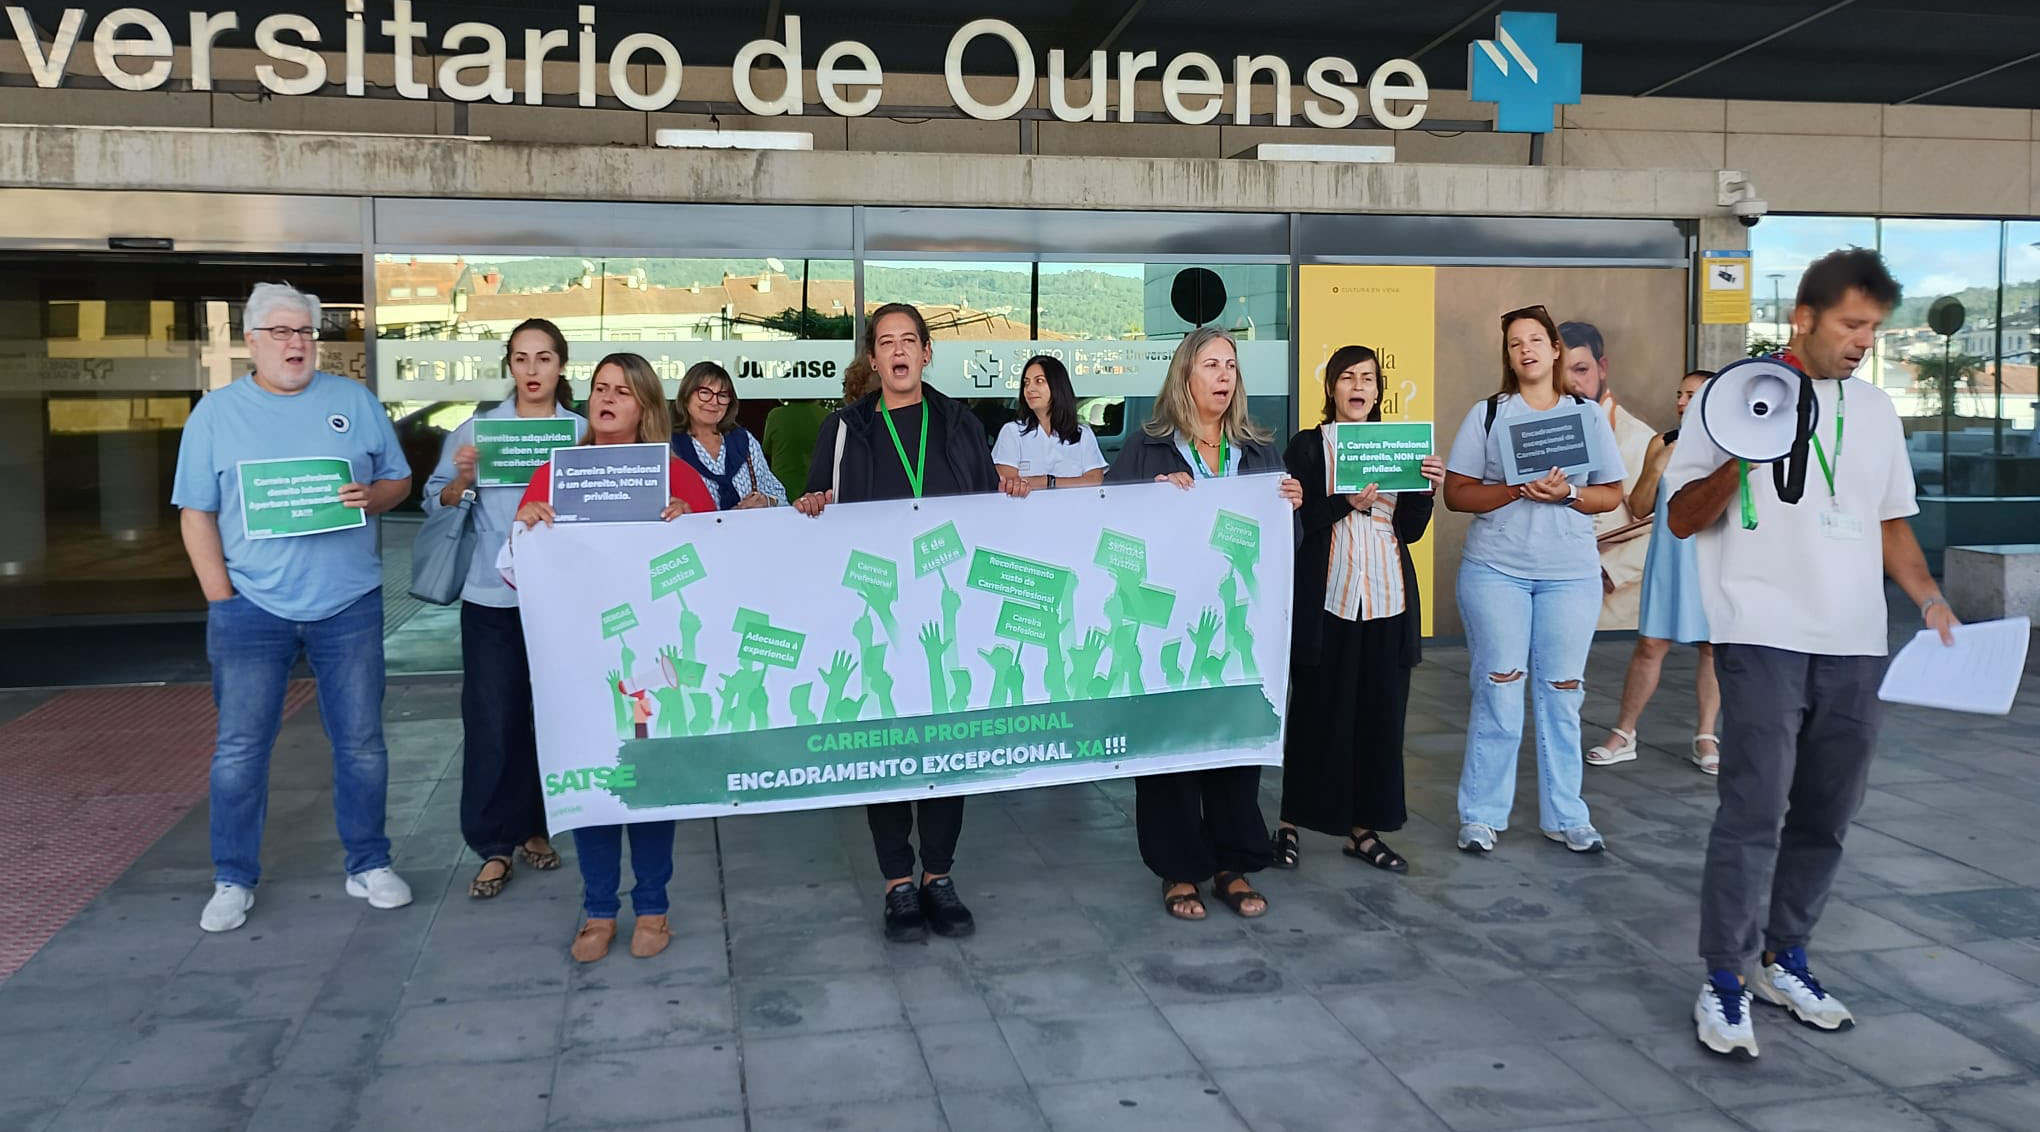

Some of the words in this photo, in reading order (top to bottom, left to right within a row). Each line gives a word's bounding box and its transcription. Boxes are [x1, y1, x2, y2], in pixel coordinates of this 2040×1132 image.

[5, 0, 683, 112] versitario
[732, 15, 884, 118] de
[943, 18, 1429, 131] Ourense
[734, 355, 837, 379] Ourense
[521, 433, 572, 444] adquiridos
[1347, 440, 1381, 449] Carreira
[1382, 440, 1429, 449] Profesional
[500, 447, 533, 455] deben
[533, 447, 548, 455] ser
[1359, 453, 1393, 461] dereito,
[1394, 452, 1414, 461] NON
[1516, 449, 1545, 459] Carreira
[1545, 441, 1584, 454] Profesional
[492, 458, 549, 467] recoñecido
[1362, 464, 1403, 474] privilexio.
[555, 468, 563, 477] A
[566, 466, 605, 476] Carreira
[606, 464, 661, 475] Profesional
[558, 480, 565, 489] é
[581, 479, 619, 488] dereito,
[620, 478, 643, 487] NON
[584, 491, 632, 503] privilexio.
[1224, 523, 1253, 537] Carreira
[930, 538, 945, 551] de
[1217, 532, 1256, 548] Profesional
[651, 554, 689, 578] SERGAS
[857, 561, 888, 577] Carreira
[848, 570, 893, 589] Profesional
[1000, 572, 1024, 585] xusto
[1024, 578, 1036, 587] de
[1012, 614, 1042, 627] Carreira
[1004, 622, 1046, 640] Profesional
[745, 632, 791, 649] Adecuada
[743, 645, 795, 662] experiencia
[807, 727, 919, 753] CARREIRA
[924, 711, 1074, 743] PROFESIONAL
[726, 757, 918, 792] ENCADRAMENTO
[922, 742, 1073, 774] EXCEPCIONAL
[1075, 735, 1127, 759] XA!!!
[545, 764, 638, 797] SATSE
